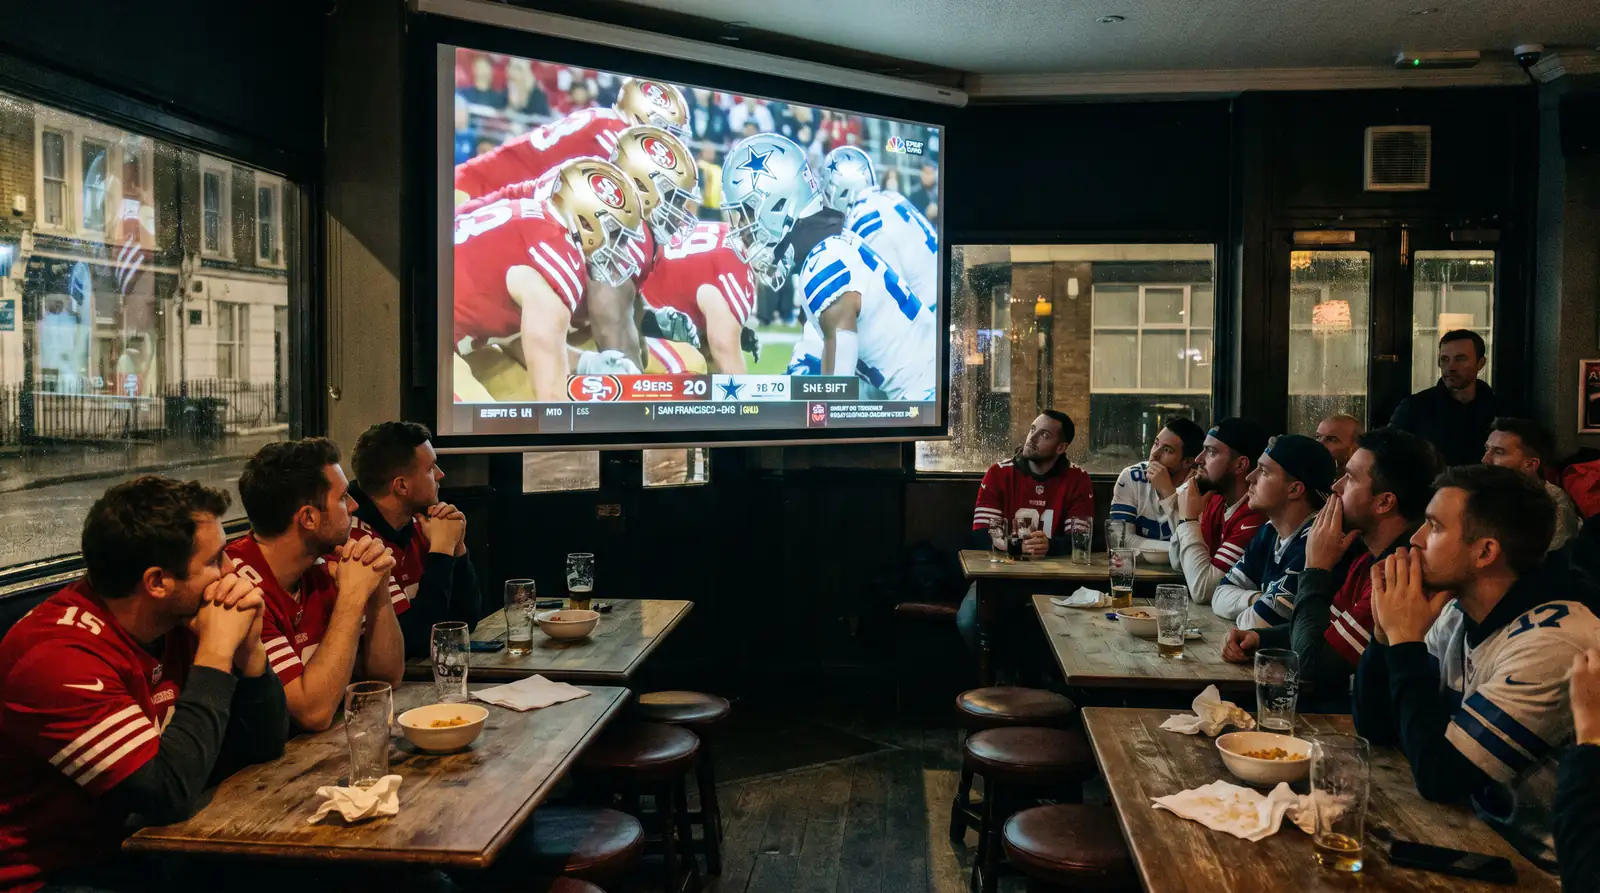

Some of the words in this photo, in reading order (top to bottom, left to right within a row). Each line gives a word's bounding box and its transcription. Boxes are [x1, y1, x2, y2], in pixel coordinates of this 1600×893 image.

[632, 380, 673, 391] 49ERS
[683, 380, 707, 395] 20
[770, 382, 785, 392] 70
[657, 406, 674, 415] SAN
[56, 606, 105, 636] 15
